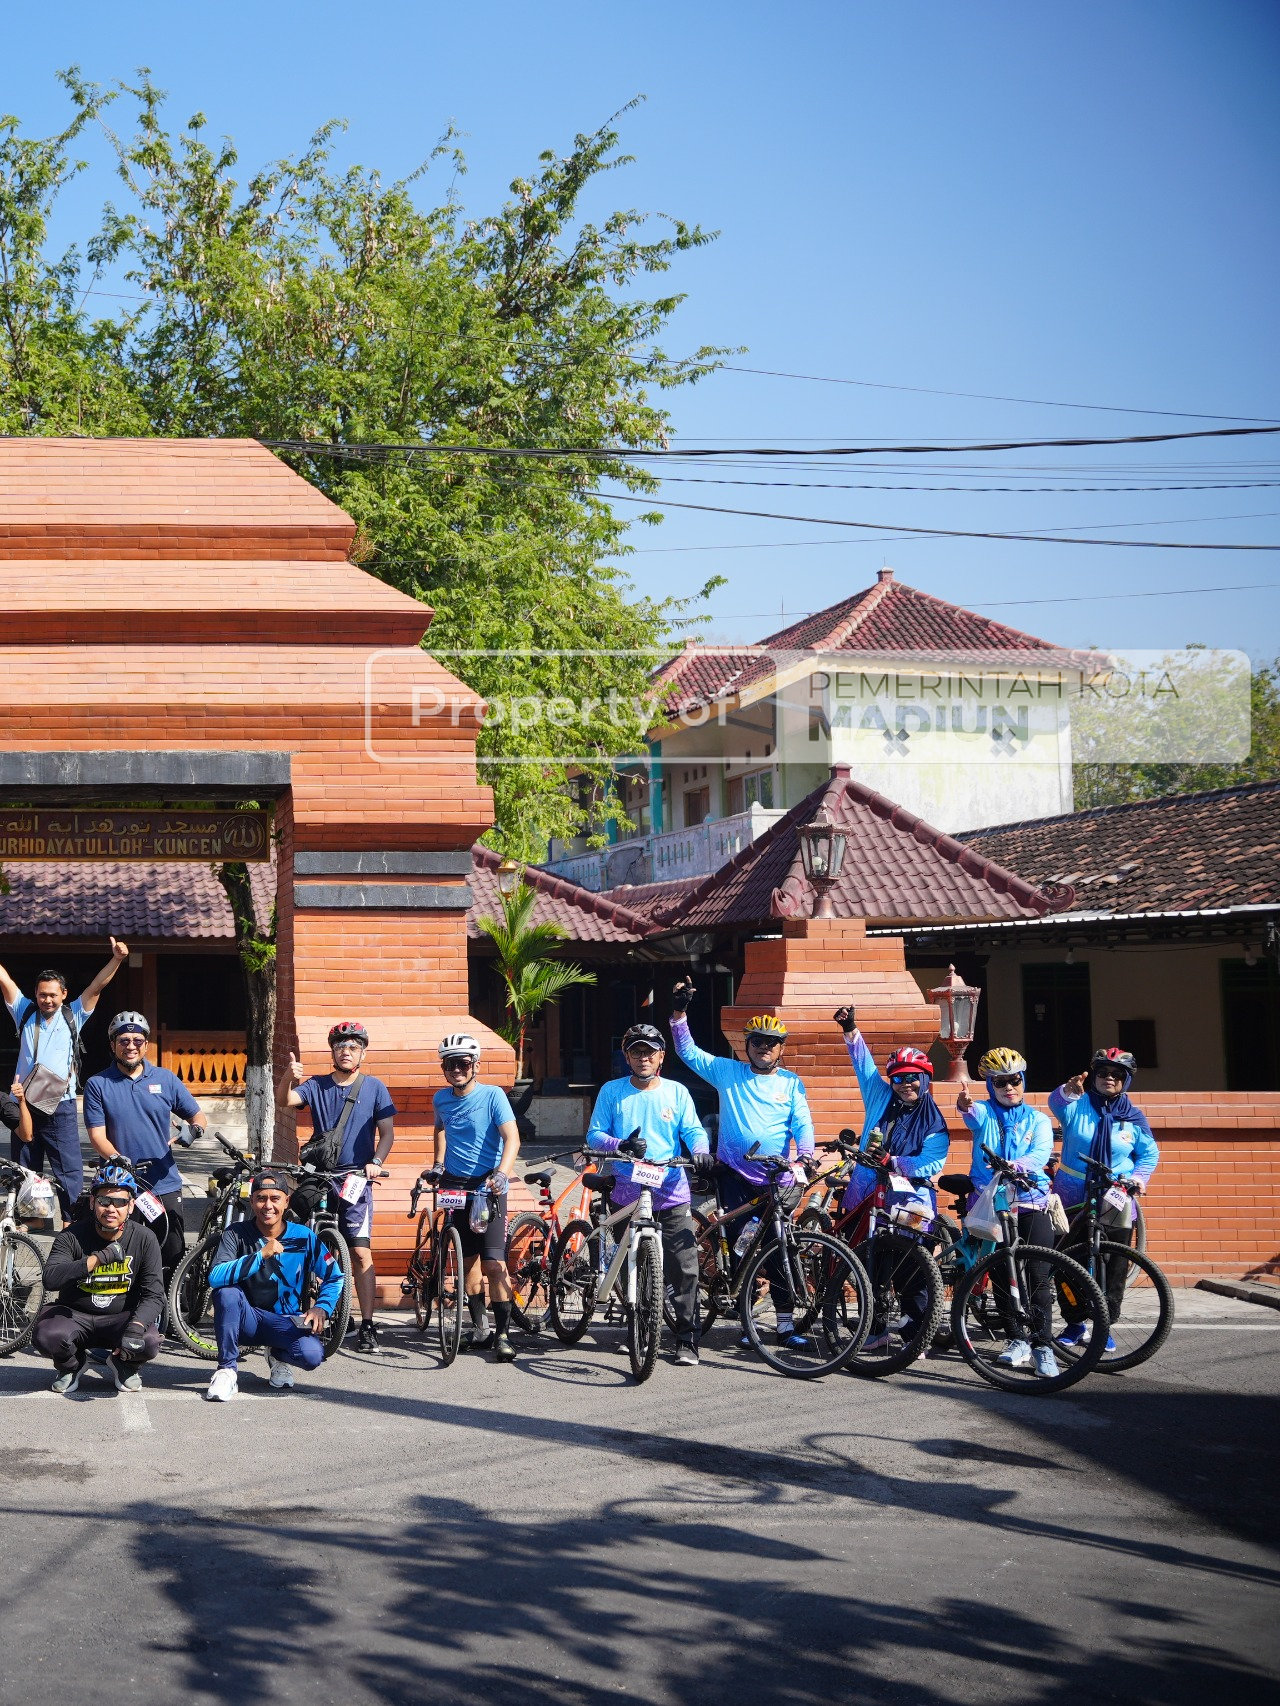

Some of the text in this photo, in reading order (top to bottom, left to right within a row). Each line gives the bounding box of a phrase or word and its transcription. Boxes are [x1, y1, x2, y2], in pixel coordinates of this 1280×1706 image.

[636, 1170, 660, 1181] 20010
[440, 1197, 463, 1205] 20019
[140, 1197, 158, 1217] 20005
